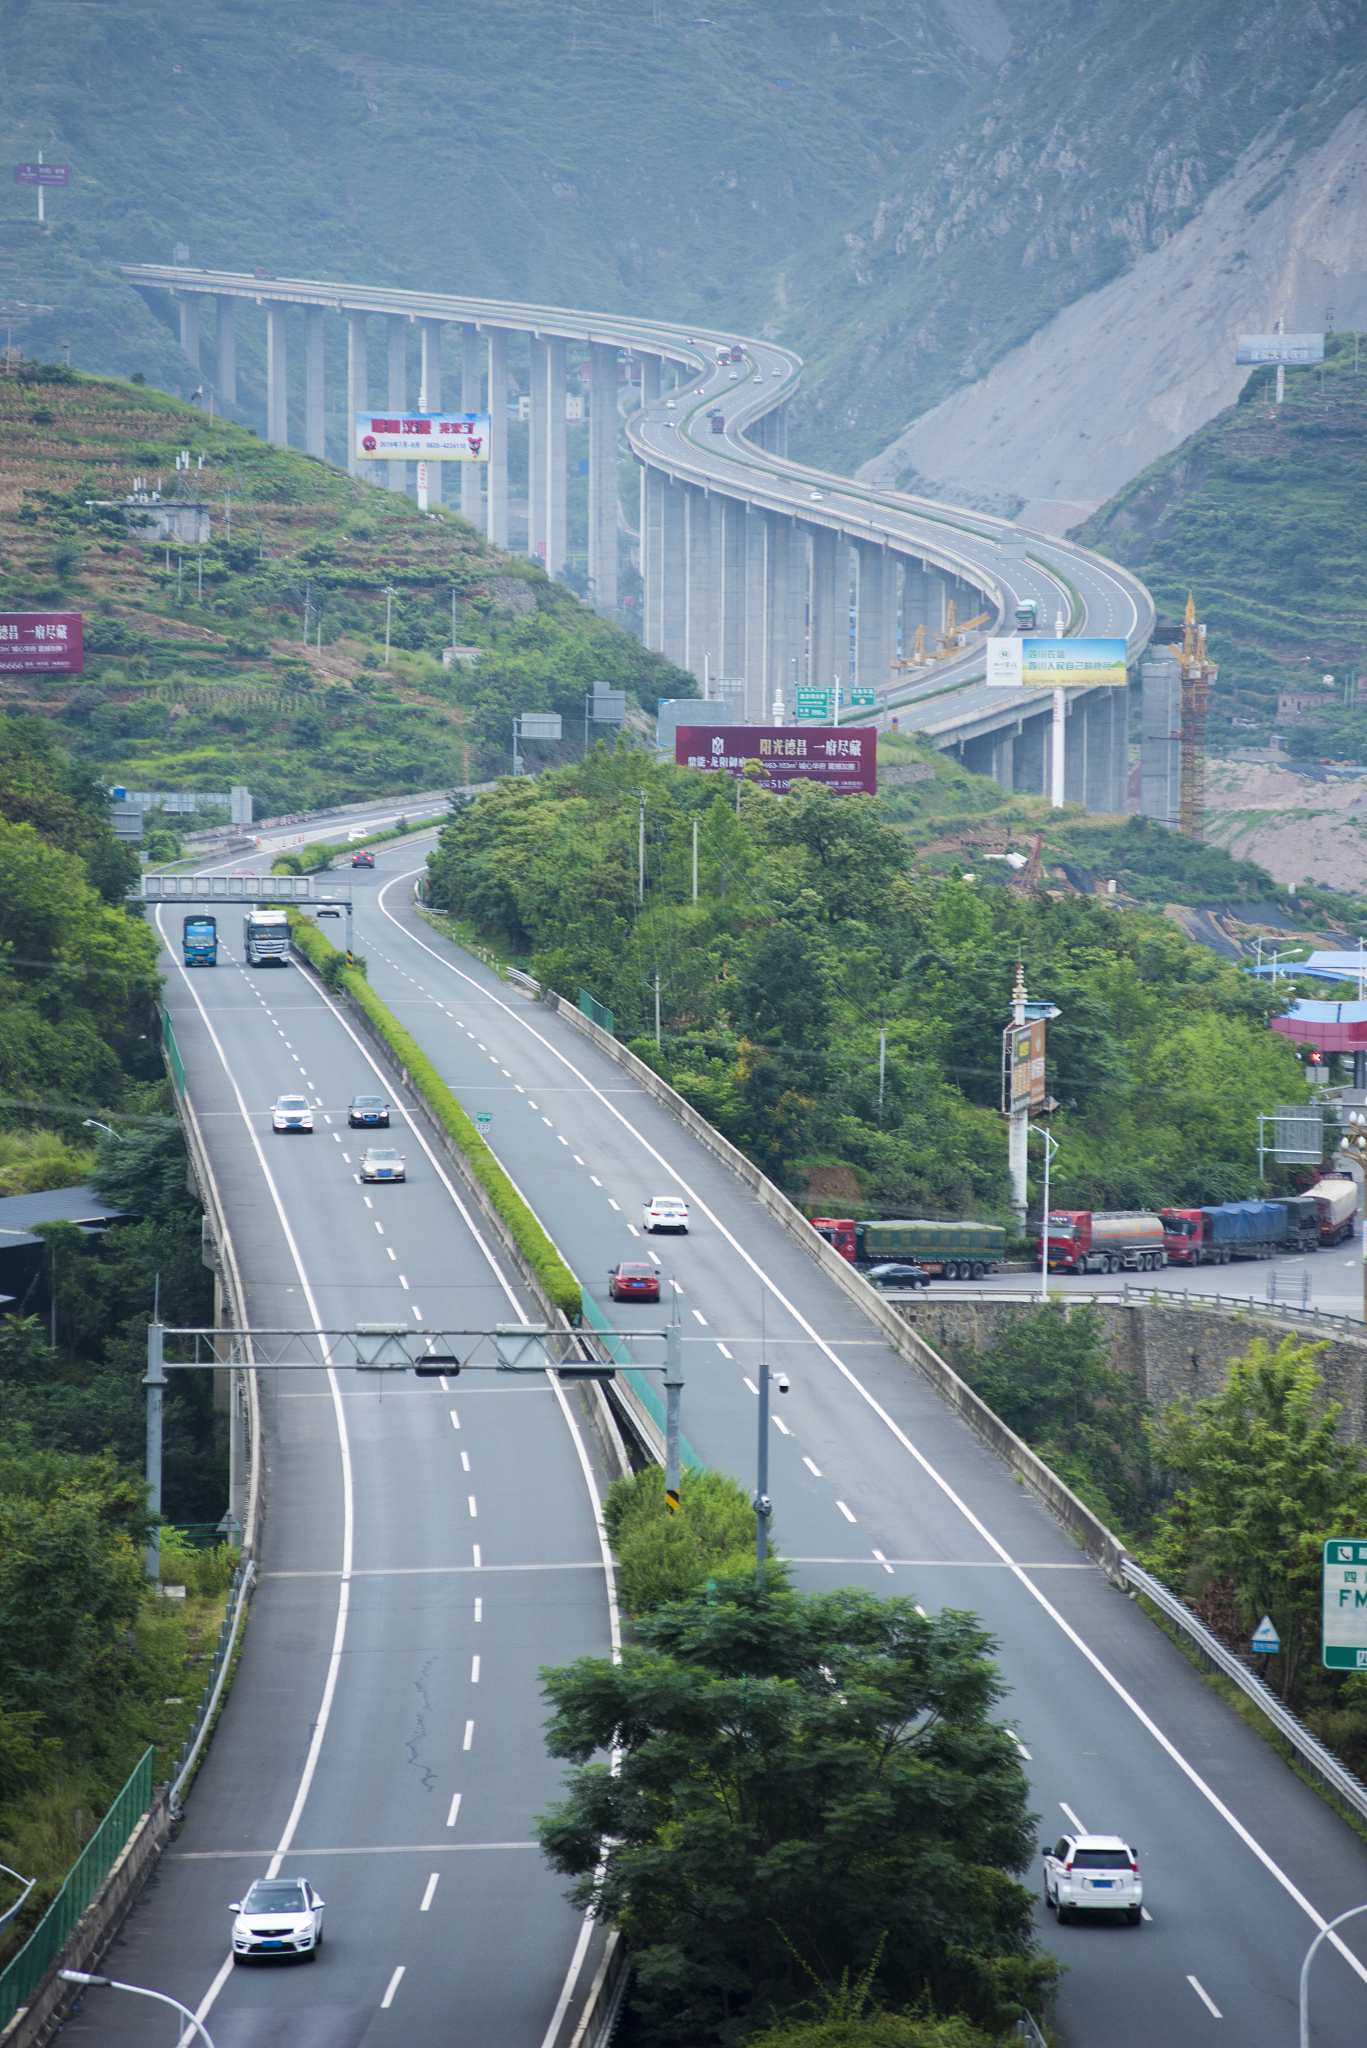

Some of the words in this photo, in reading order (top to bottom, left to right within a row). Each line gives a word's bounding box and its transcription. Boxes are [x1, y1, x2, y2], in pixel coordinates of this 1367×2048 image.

[759, 738, 807, 756] 阳光德昌
[813, 738, 862, 757] 一府尽藏
